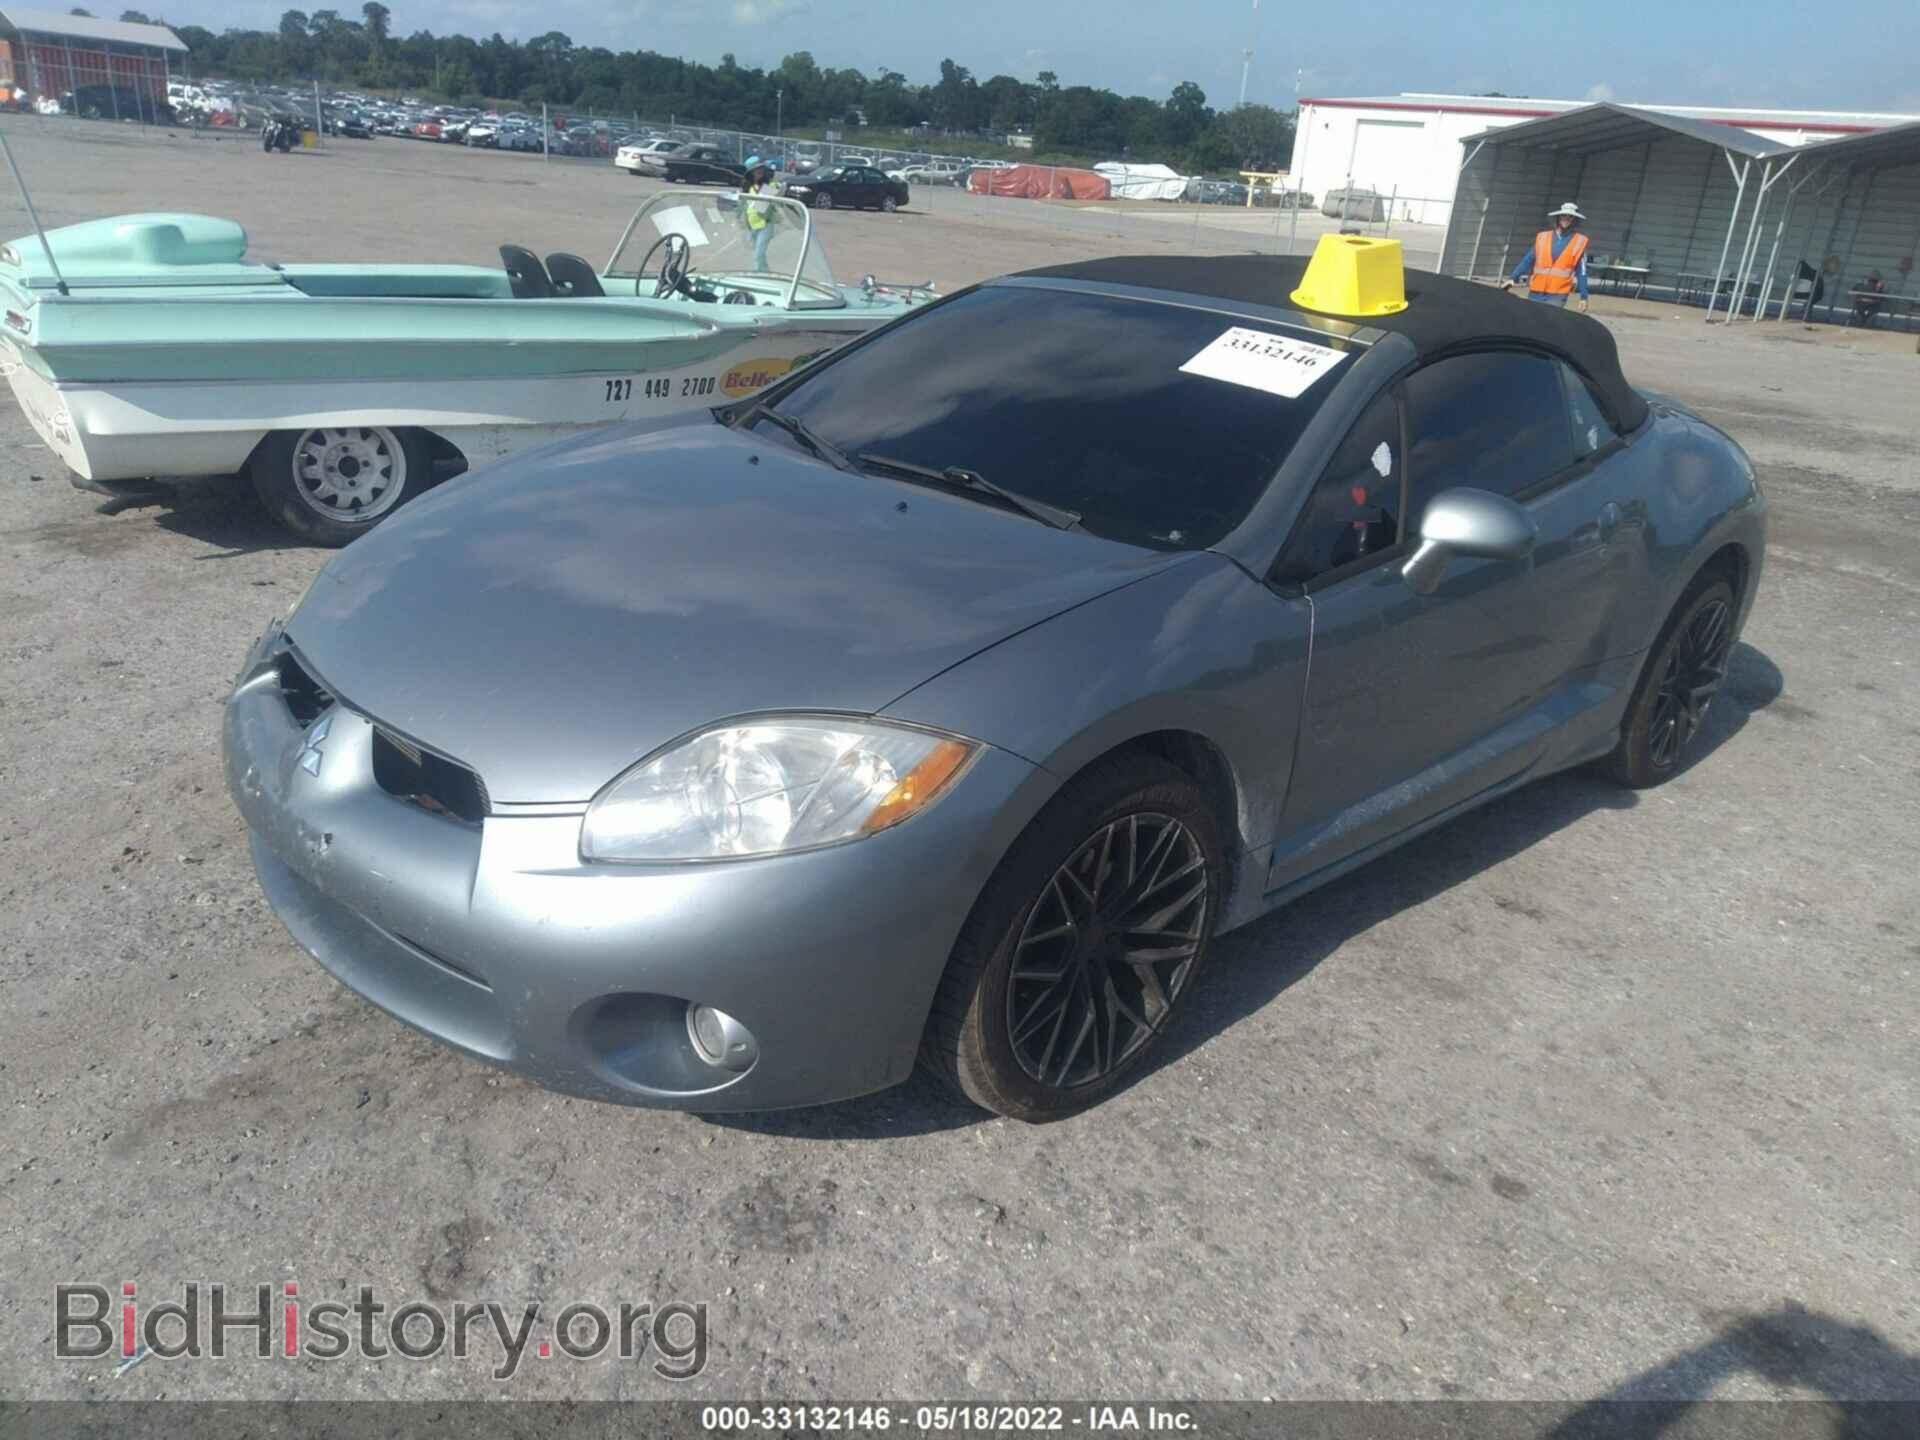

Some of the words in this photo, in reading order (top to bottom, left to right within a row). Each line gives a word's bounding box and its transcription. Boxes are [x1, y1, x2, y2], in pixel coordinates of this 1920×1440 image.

[605, 380, 632, 401] 727
[645, 379, 670, 397] 449
[682, 377, 716, 395] 2700
